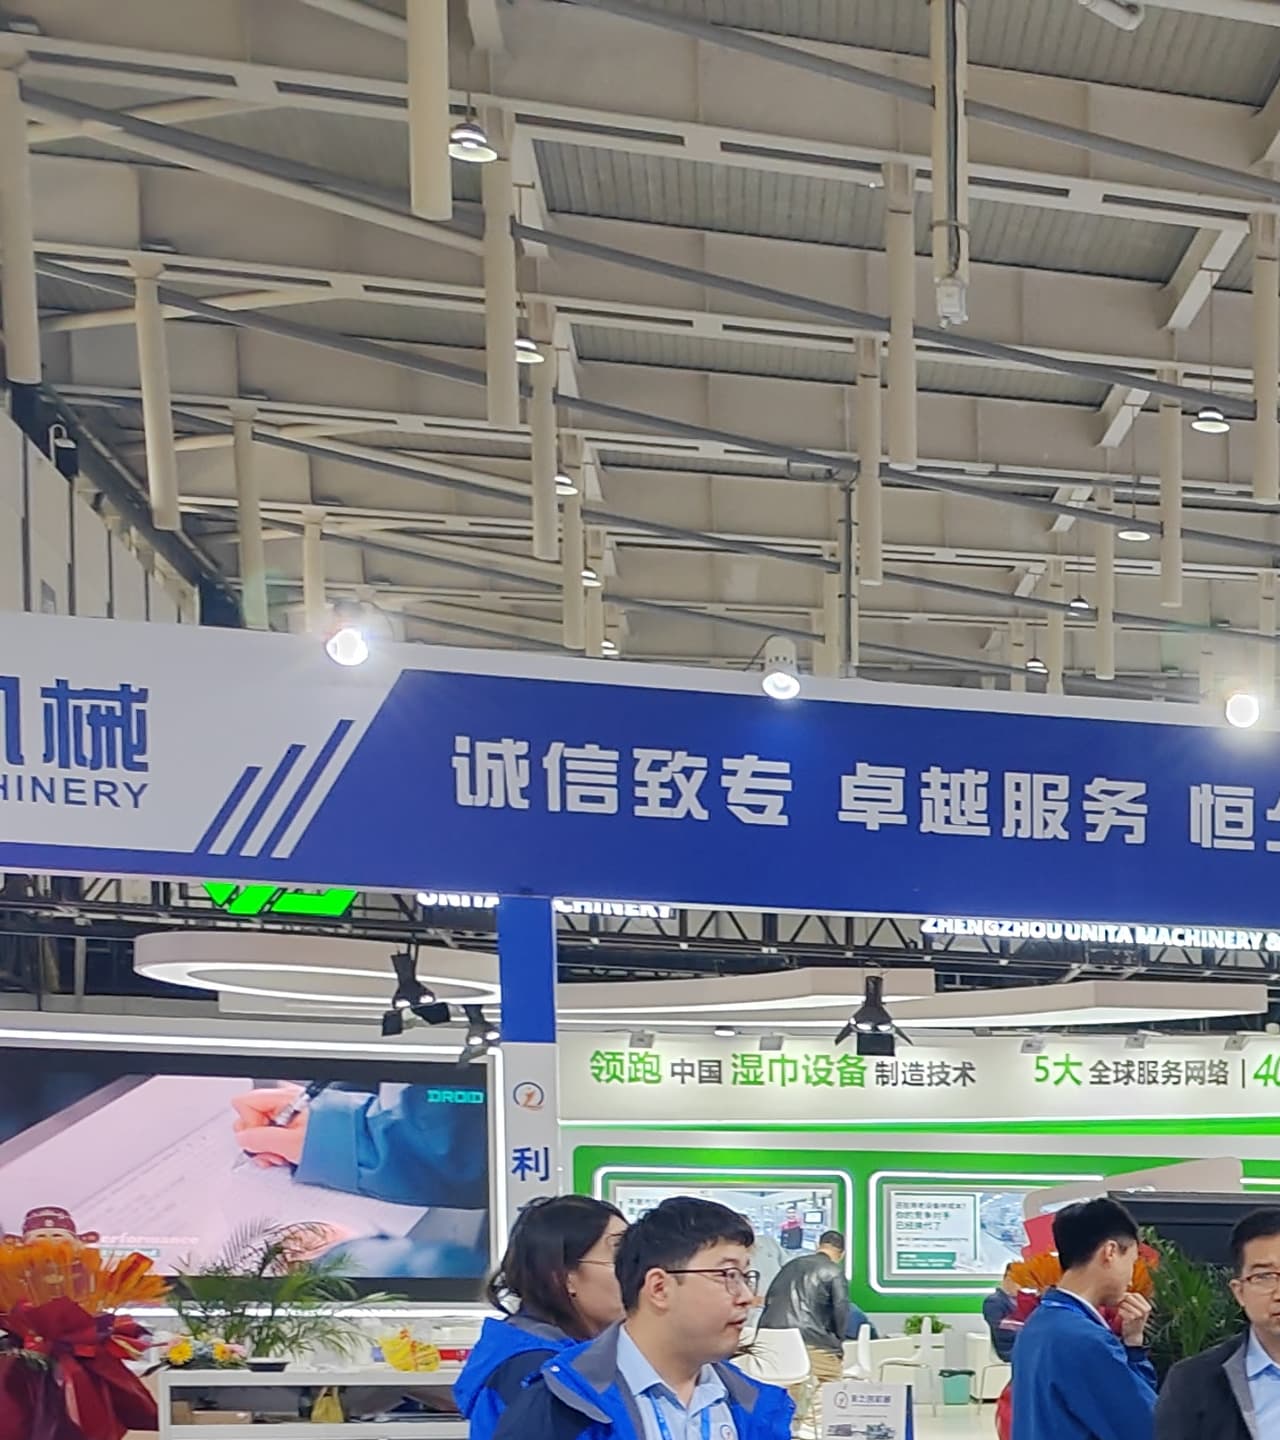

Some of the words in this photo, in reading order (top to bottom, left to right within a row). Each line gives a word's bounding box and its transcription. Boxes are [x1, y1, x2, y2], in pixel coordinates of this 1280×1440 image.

[450, 735, 793, 827] 诚信致专
[838, 761, 1149, 845] 卓越服务
[921, 917, 1065, 940] ZHENGZHOU
[1066, 924, 1133, 945] UNITA
[1135, 926, 1264, 953] MACHINERY
[590, 1050, 662, 1085] 领跑
[670, 1059, 722, 1085] 中国
[731, 1053, 867, 1087] 湿巾设备
[875, 1060, 977, 1087] 制造技术
[1034, 1053, 1082, 1087] 5大
[1089, 1059, 1230, 1087] 全球服务网络
[511, 1146, 550, 1182] 利
